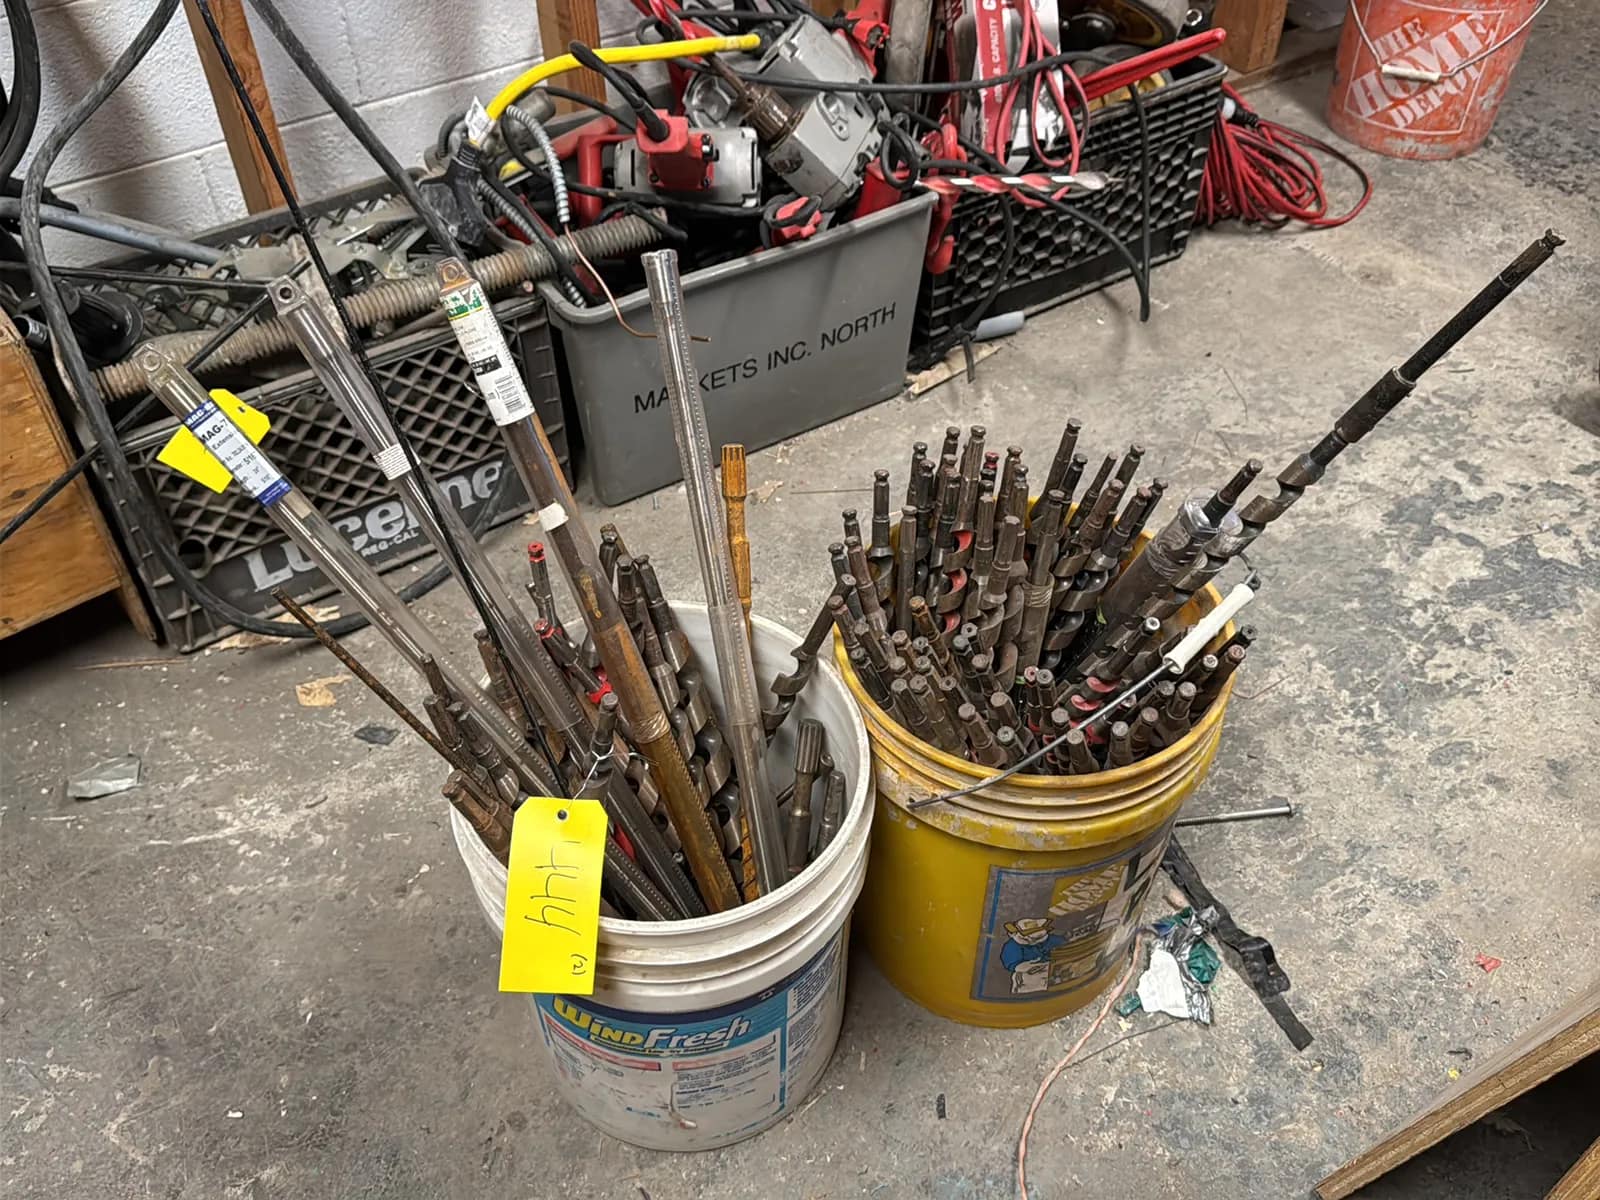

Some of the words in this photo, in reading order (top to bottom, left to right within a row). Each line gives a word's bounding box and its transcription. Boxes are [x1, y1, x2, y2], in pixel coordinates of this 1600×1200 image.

[1373, 17, 1431, 62] THE
[1350, 13, 1494, 118] HOME
[634, 359, 757, 413] MAKETS
[767, 341, 812, 370] INC.
[821, 302, 896, 350] NORTH
[361, 530, 419, 558] REG-CAL
[643, 1015, 751, 1049] Fresh
